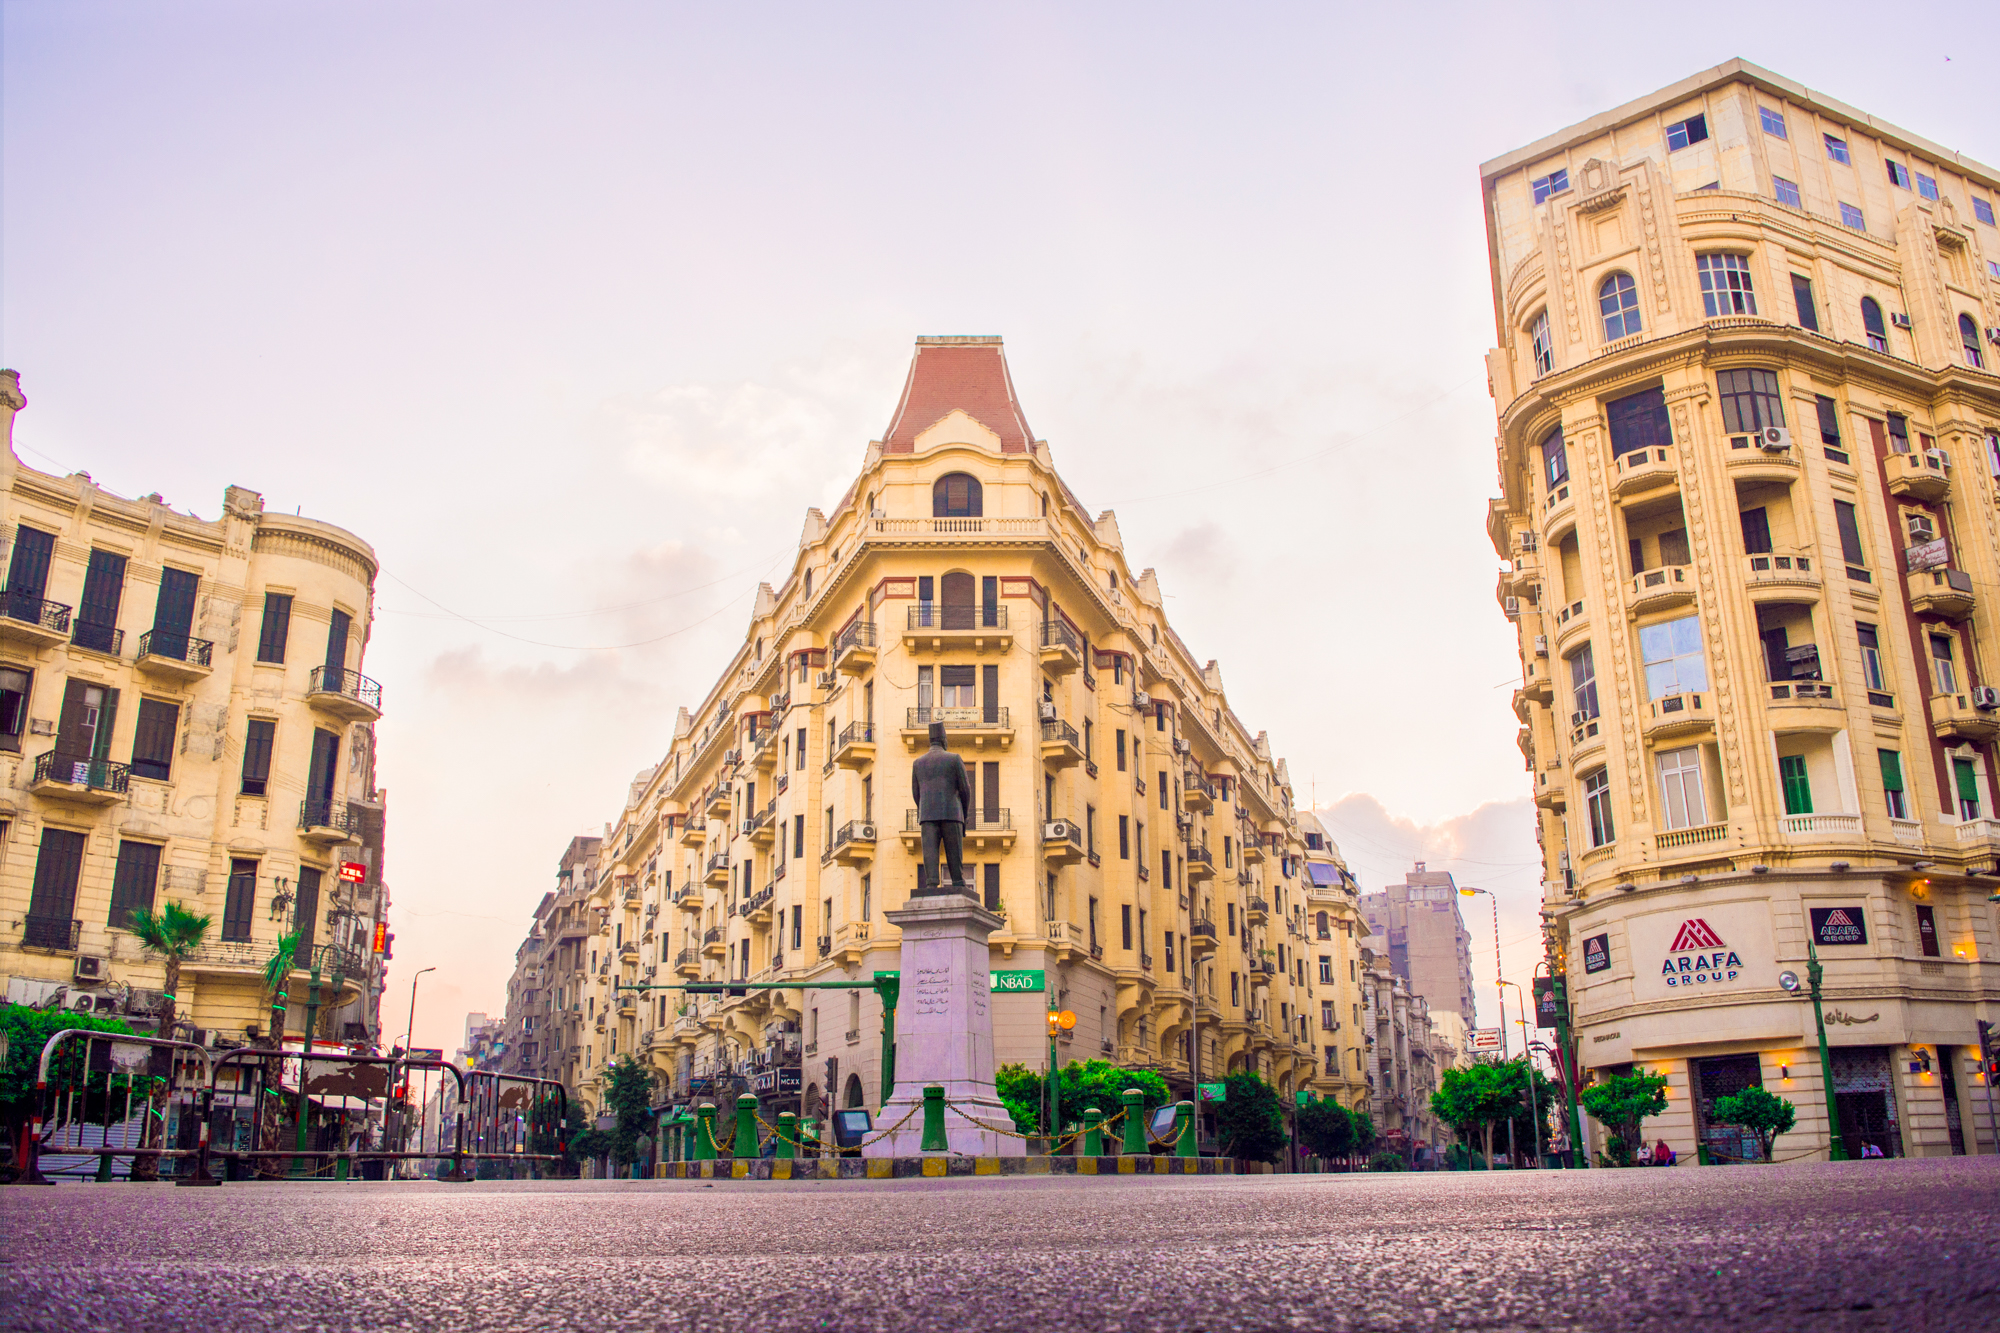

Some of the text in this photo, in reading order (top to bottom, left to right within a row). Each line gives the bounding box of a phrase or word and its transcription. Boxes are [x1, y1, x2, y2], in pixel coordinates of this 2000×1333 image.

[1820, 926, 1861, 935] ARAFA
[1662, 951, 1743, 975] ARAFA
[1000, 977, 1033, 988] NBAD
[1666, 970, 1738, 987] GROUP
